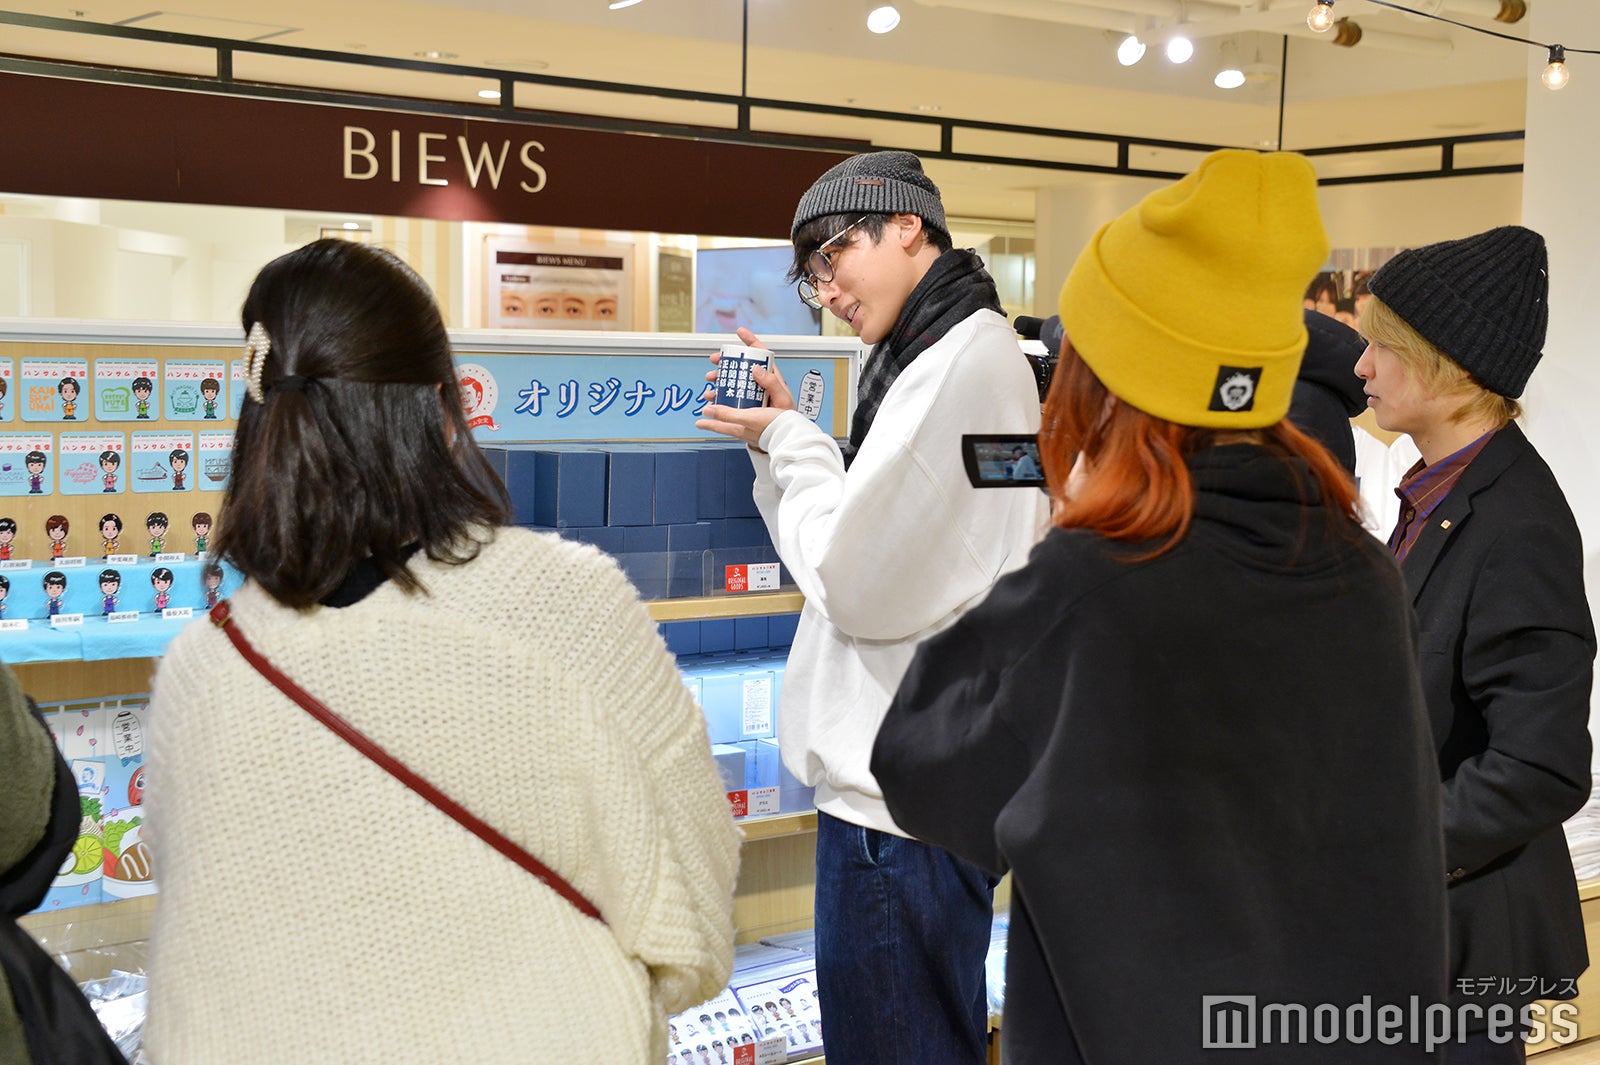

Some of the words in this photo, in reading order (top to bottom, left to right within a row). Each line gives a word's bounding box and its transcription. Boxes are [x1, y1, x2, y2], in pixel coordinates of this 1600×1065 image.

[343, 125, 548, 194] BIEWS
[804, 381, 817, 415] 営業中
